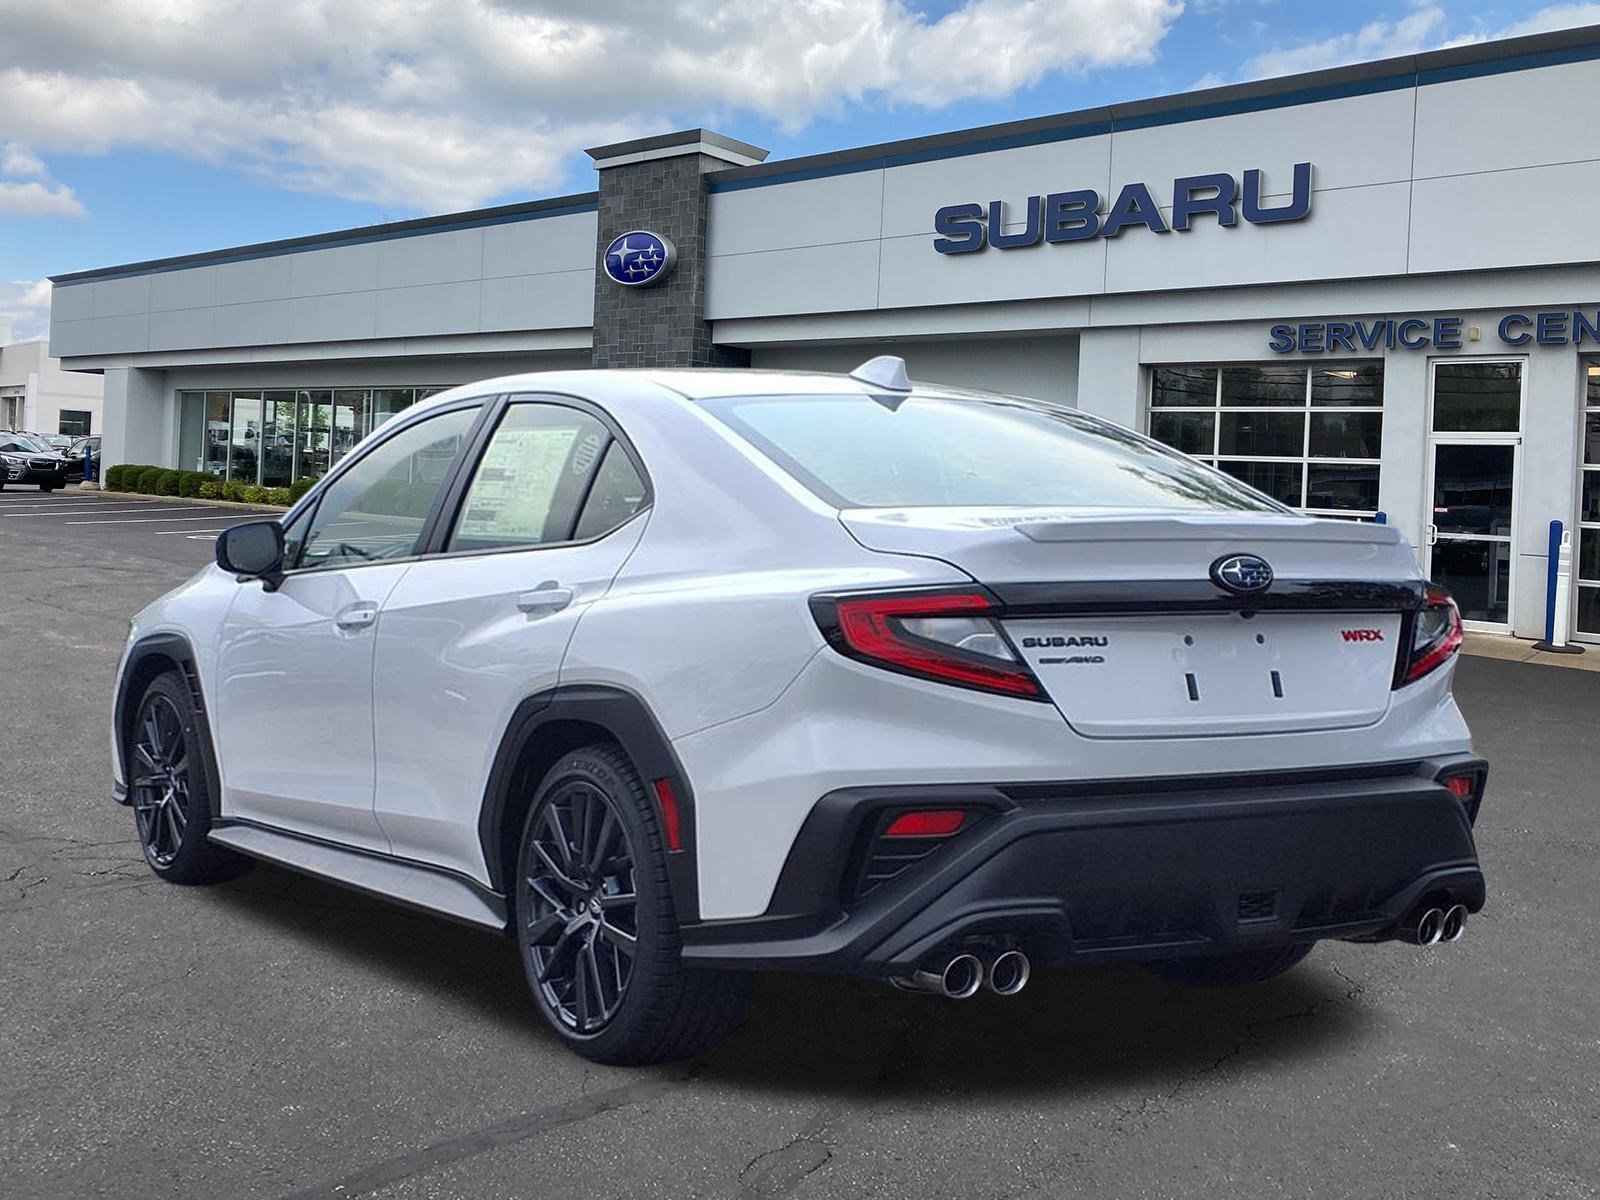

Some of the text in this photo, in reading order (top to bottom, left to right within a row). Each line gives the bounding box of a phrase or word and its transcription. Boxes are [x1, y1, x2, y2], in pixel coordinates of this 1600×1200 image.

[934, 161, 1313, 255] SUBARU
[1269, 311, 1600, 353] SERVICE CEN
[1022, 636, 1108, 648] SUBARU
[1341, 629, 1384, 642] WRX
